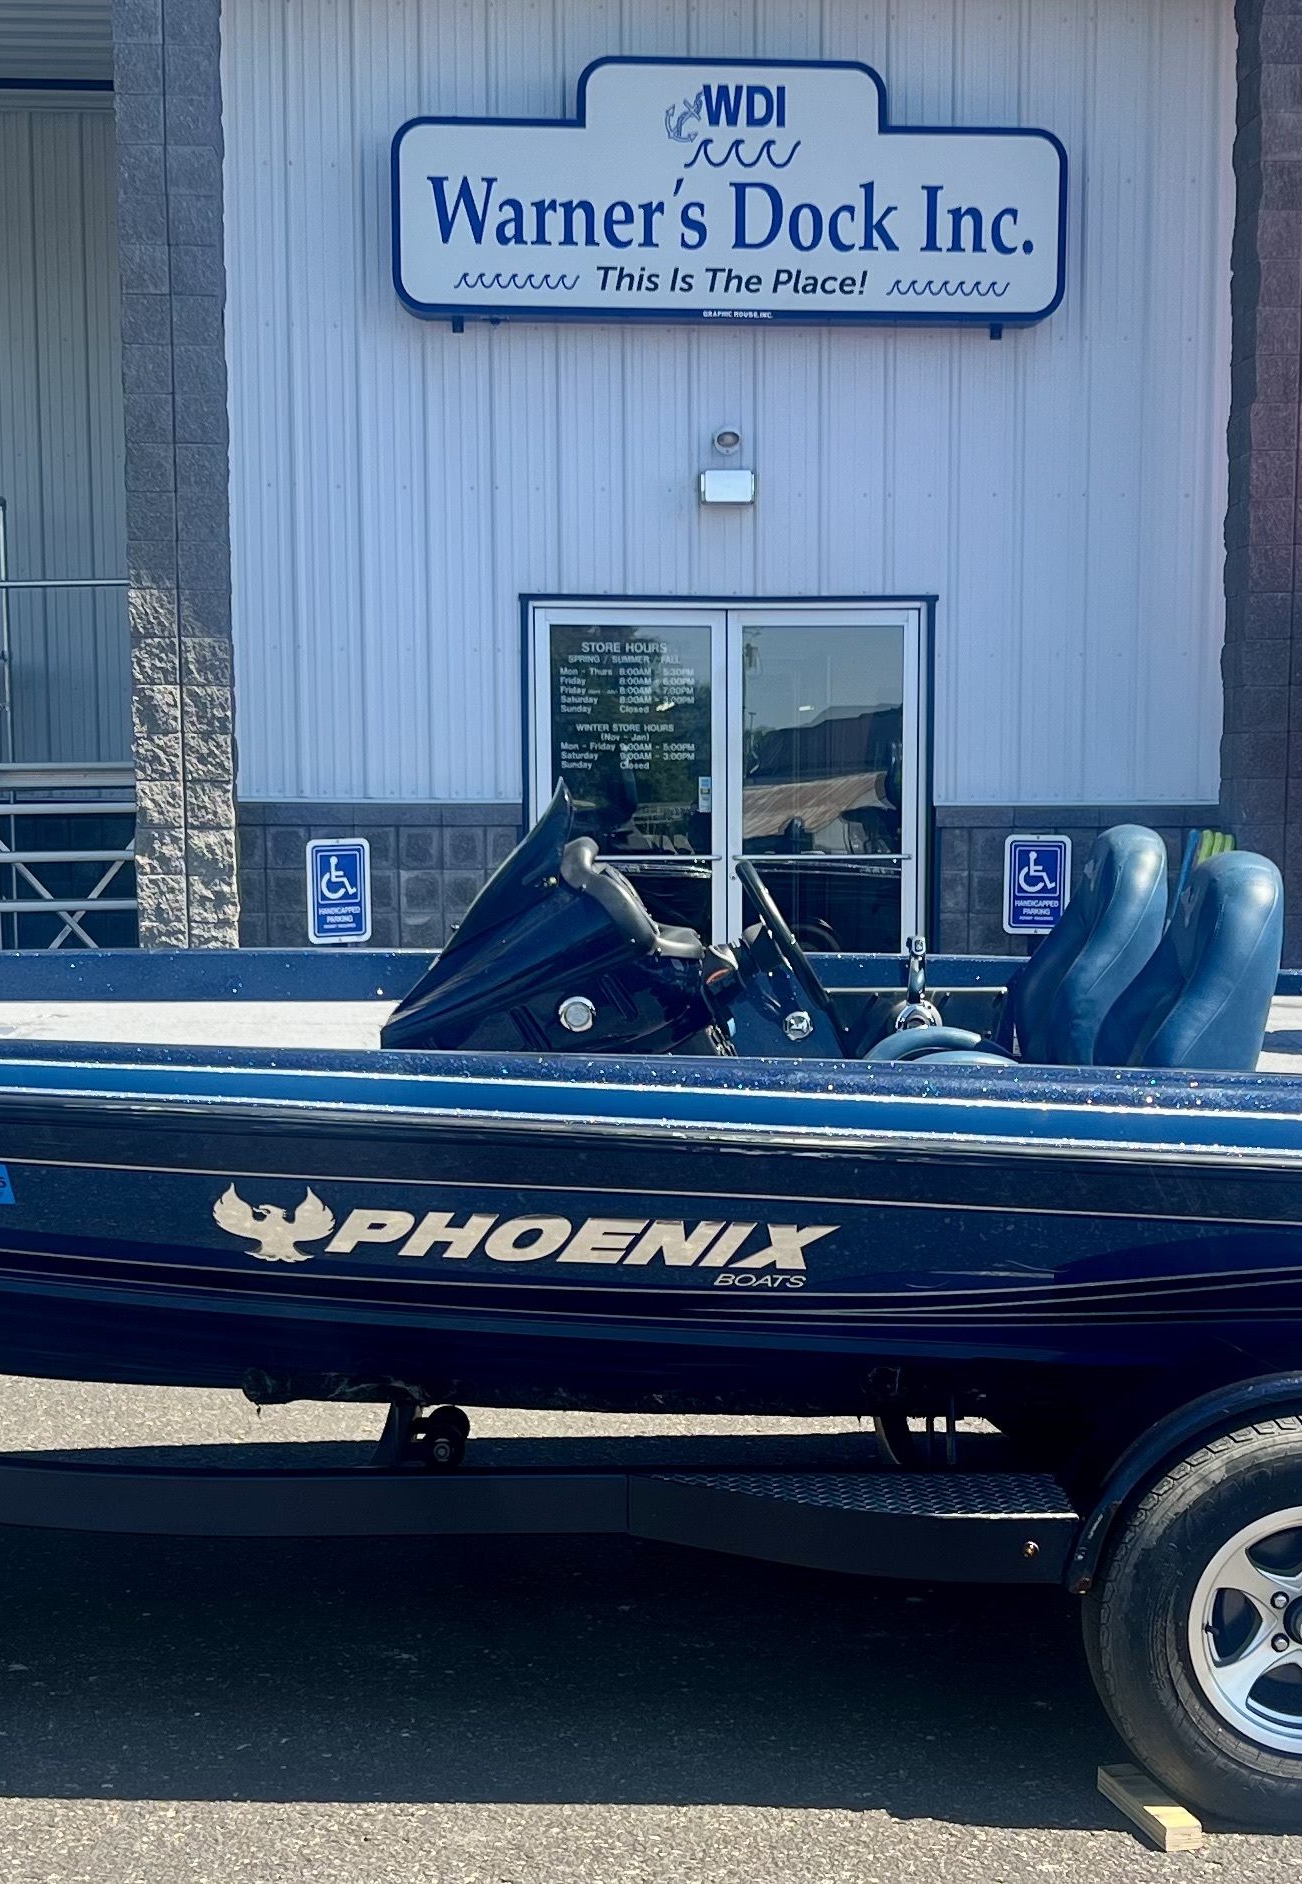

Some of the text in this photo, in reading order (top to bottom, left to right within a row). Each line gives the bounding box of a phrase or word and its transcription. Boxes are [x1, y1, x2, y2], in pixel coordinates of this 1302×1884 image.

[702, 83, 786, 129] WDI
[427, 175, 1035, 256] Warner's Dock Inc.
[596, 265, 868, 296] This Is The Place!
[581, 641, 668, 654] STORE HOURS
[568, 654, 601, 664] SPRING
[611, 655, 650, 664] SUMMER
[560, 667, 578, 676] Mon
[589, 667, 612, 676] Thurs
[560, 676, 586, 686] Friday
[560, 686, 586, 695] Friday
[560, 695, 598, 705] Saturday
[560, 704, 649, 714] Sunday Closed
[576, 723, 675, 732] WINTER STORE HOURS
[560, 742, 579, 751] Mon
[589, 742, 616, 752] Friday
[560, 751, 598, 761] Saturday
[561, 761, 649, 770] Sunday Closed
[1014, 899, 1060, 908] HANDICAPPED
[318, 905, 361, 916] HANDICAPPED
[1022, 907, 1051, 916] PARKING
[326, 914, 354, 924] PARKING
[324, 1207, 841, 1271] PHOENIX
[713, 1272, 807, 1289] BOATS
